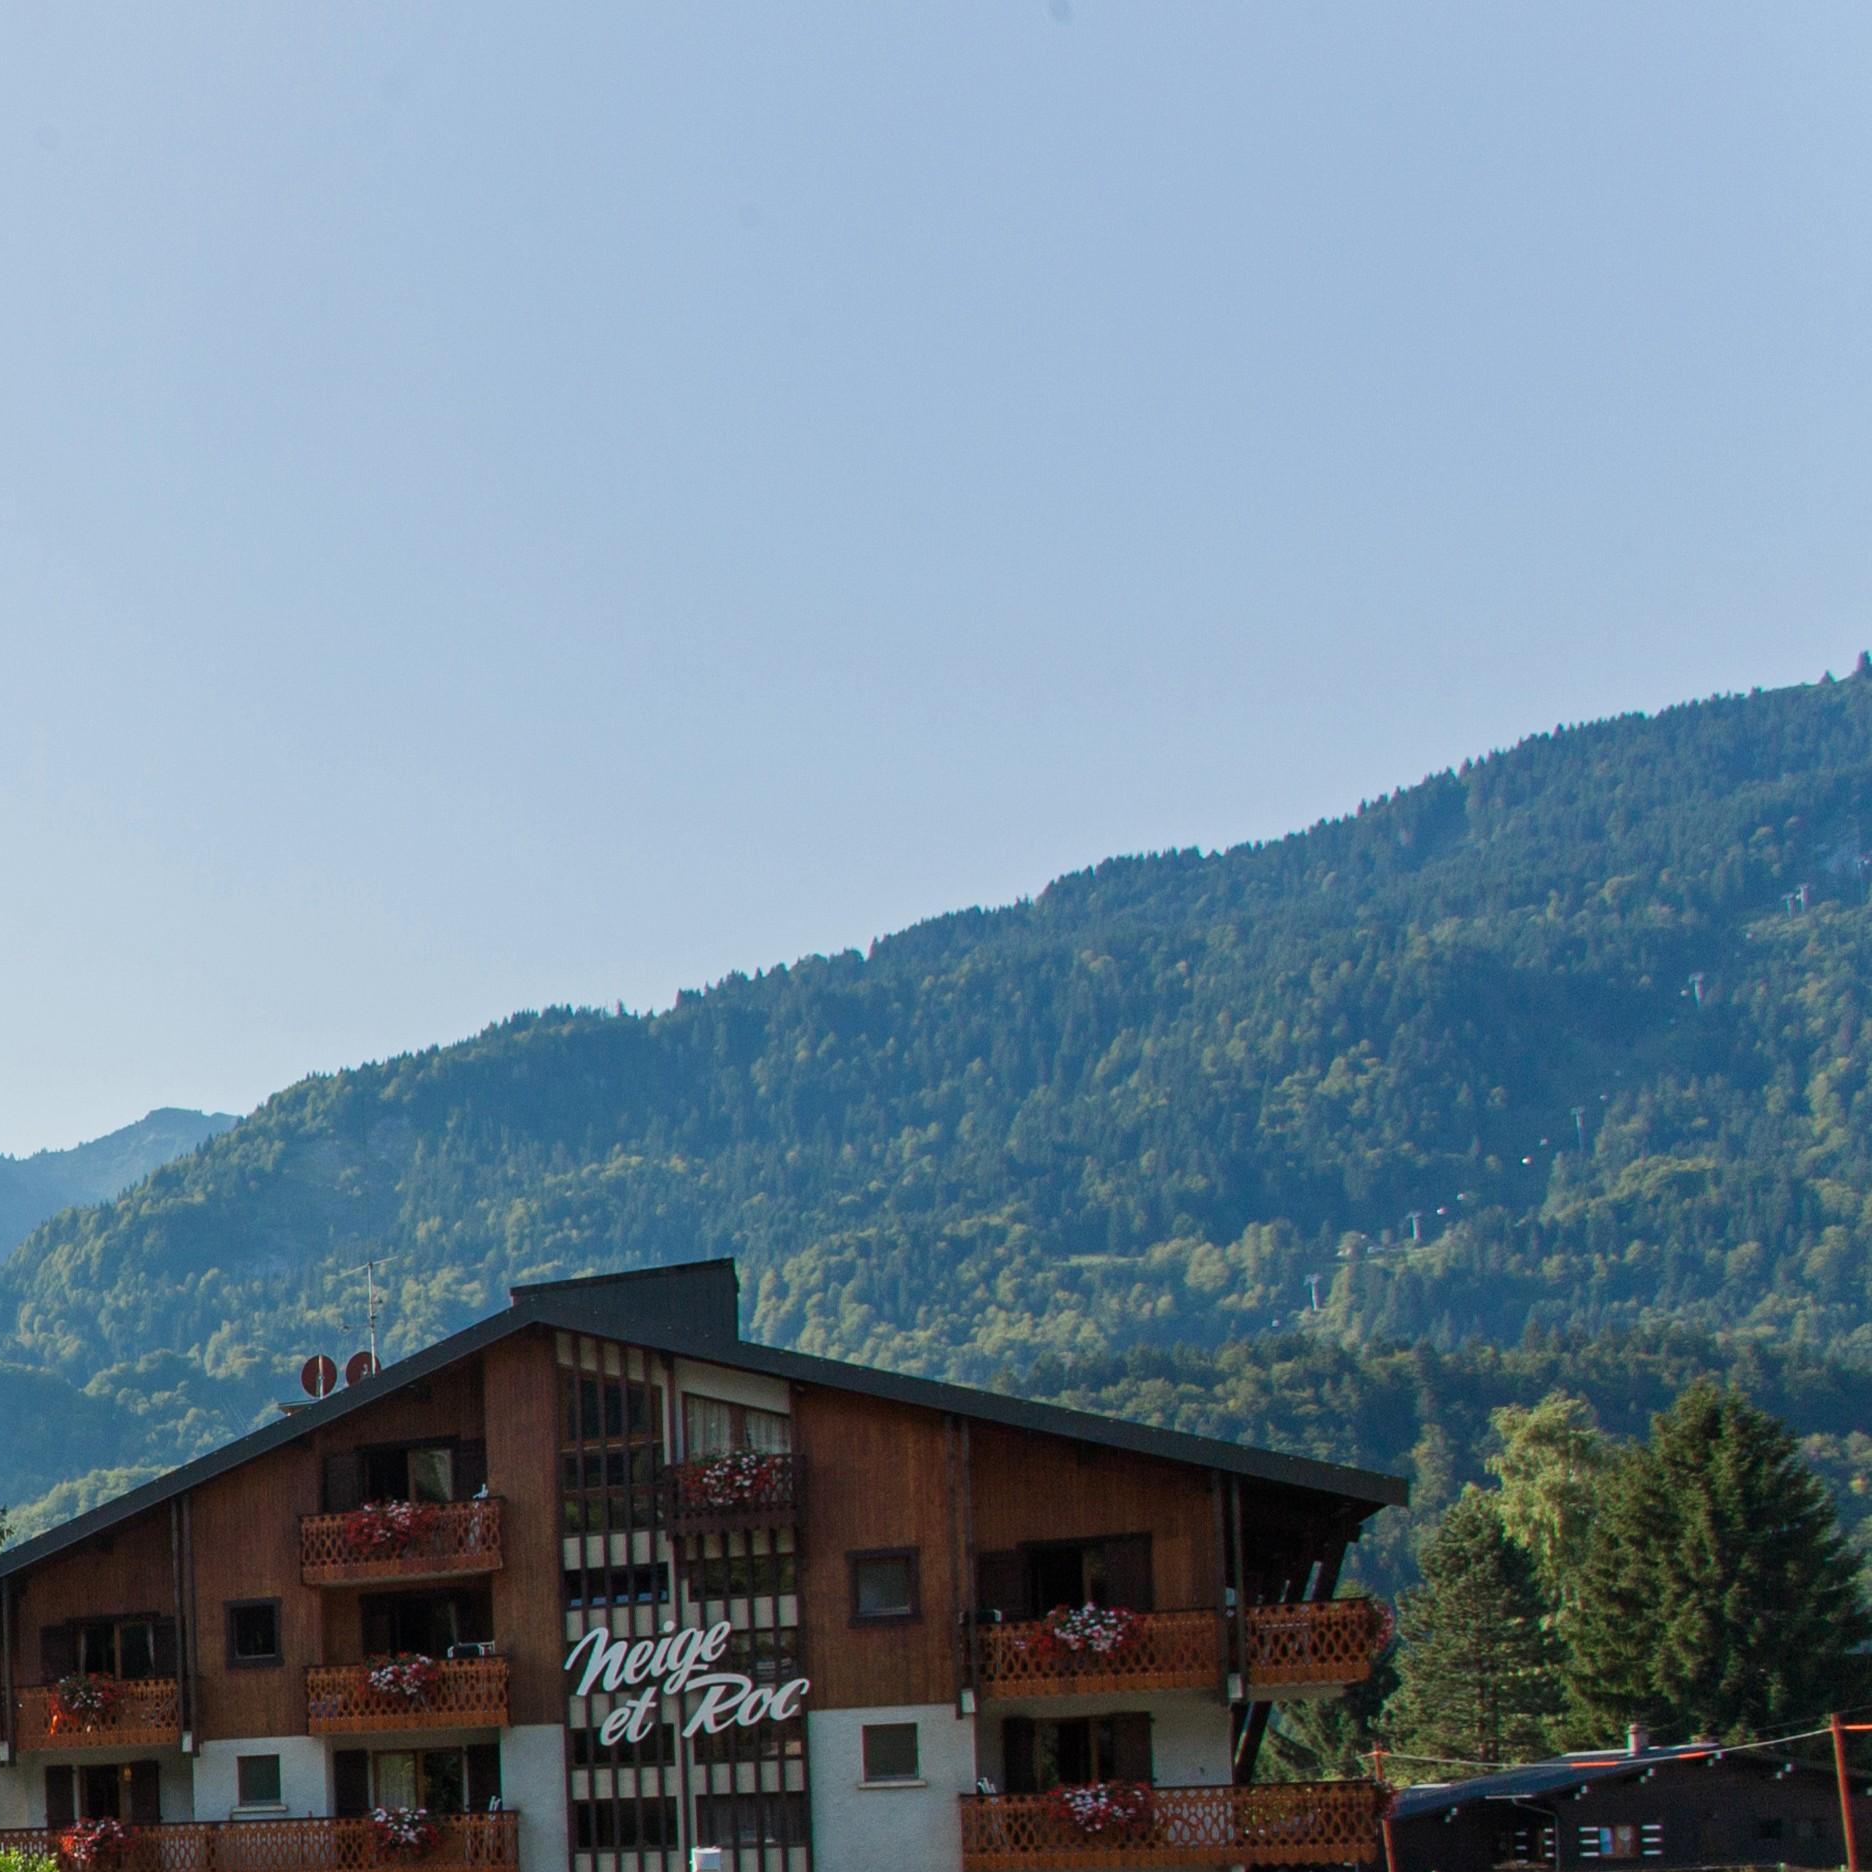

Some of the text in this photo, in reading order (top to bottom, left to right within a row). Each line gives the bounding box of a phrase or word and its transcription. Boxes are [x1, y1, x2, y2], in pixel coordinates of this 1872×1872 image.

[563, 1620, 732, 1696] Neige
[600, 1672, 810, 1746] et Roc
